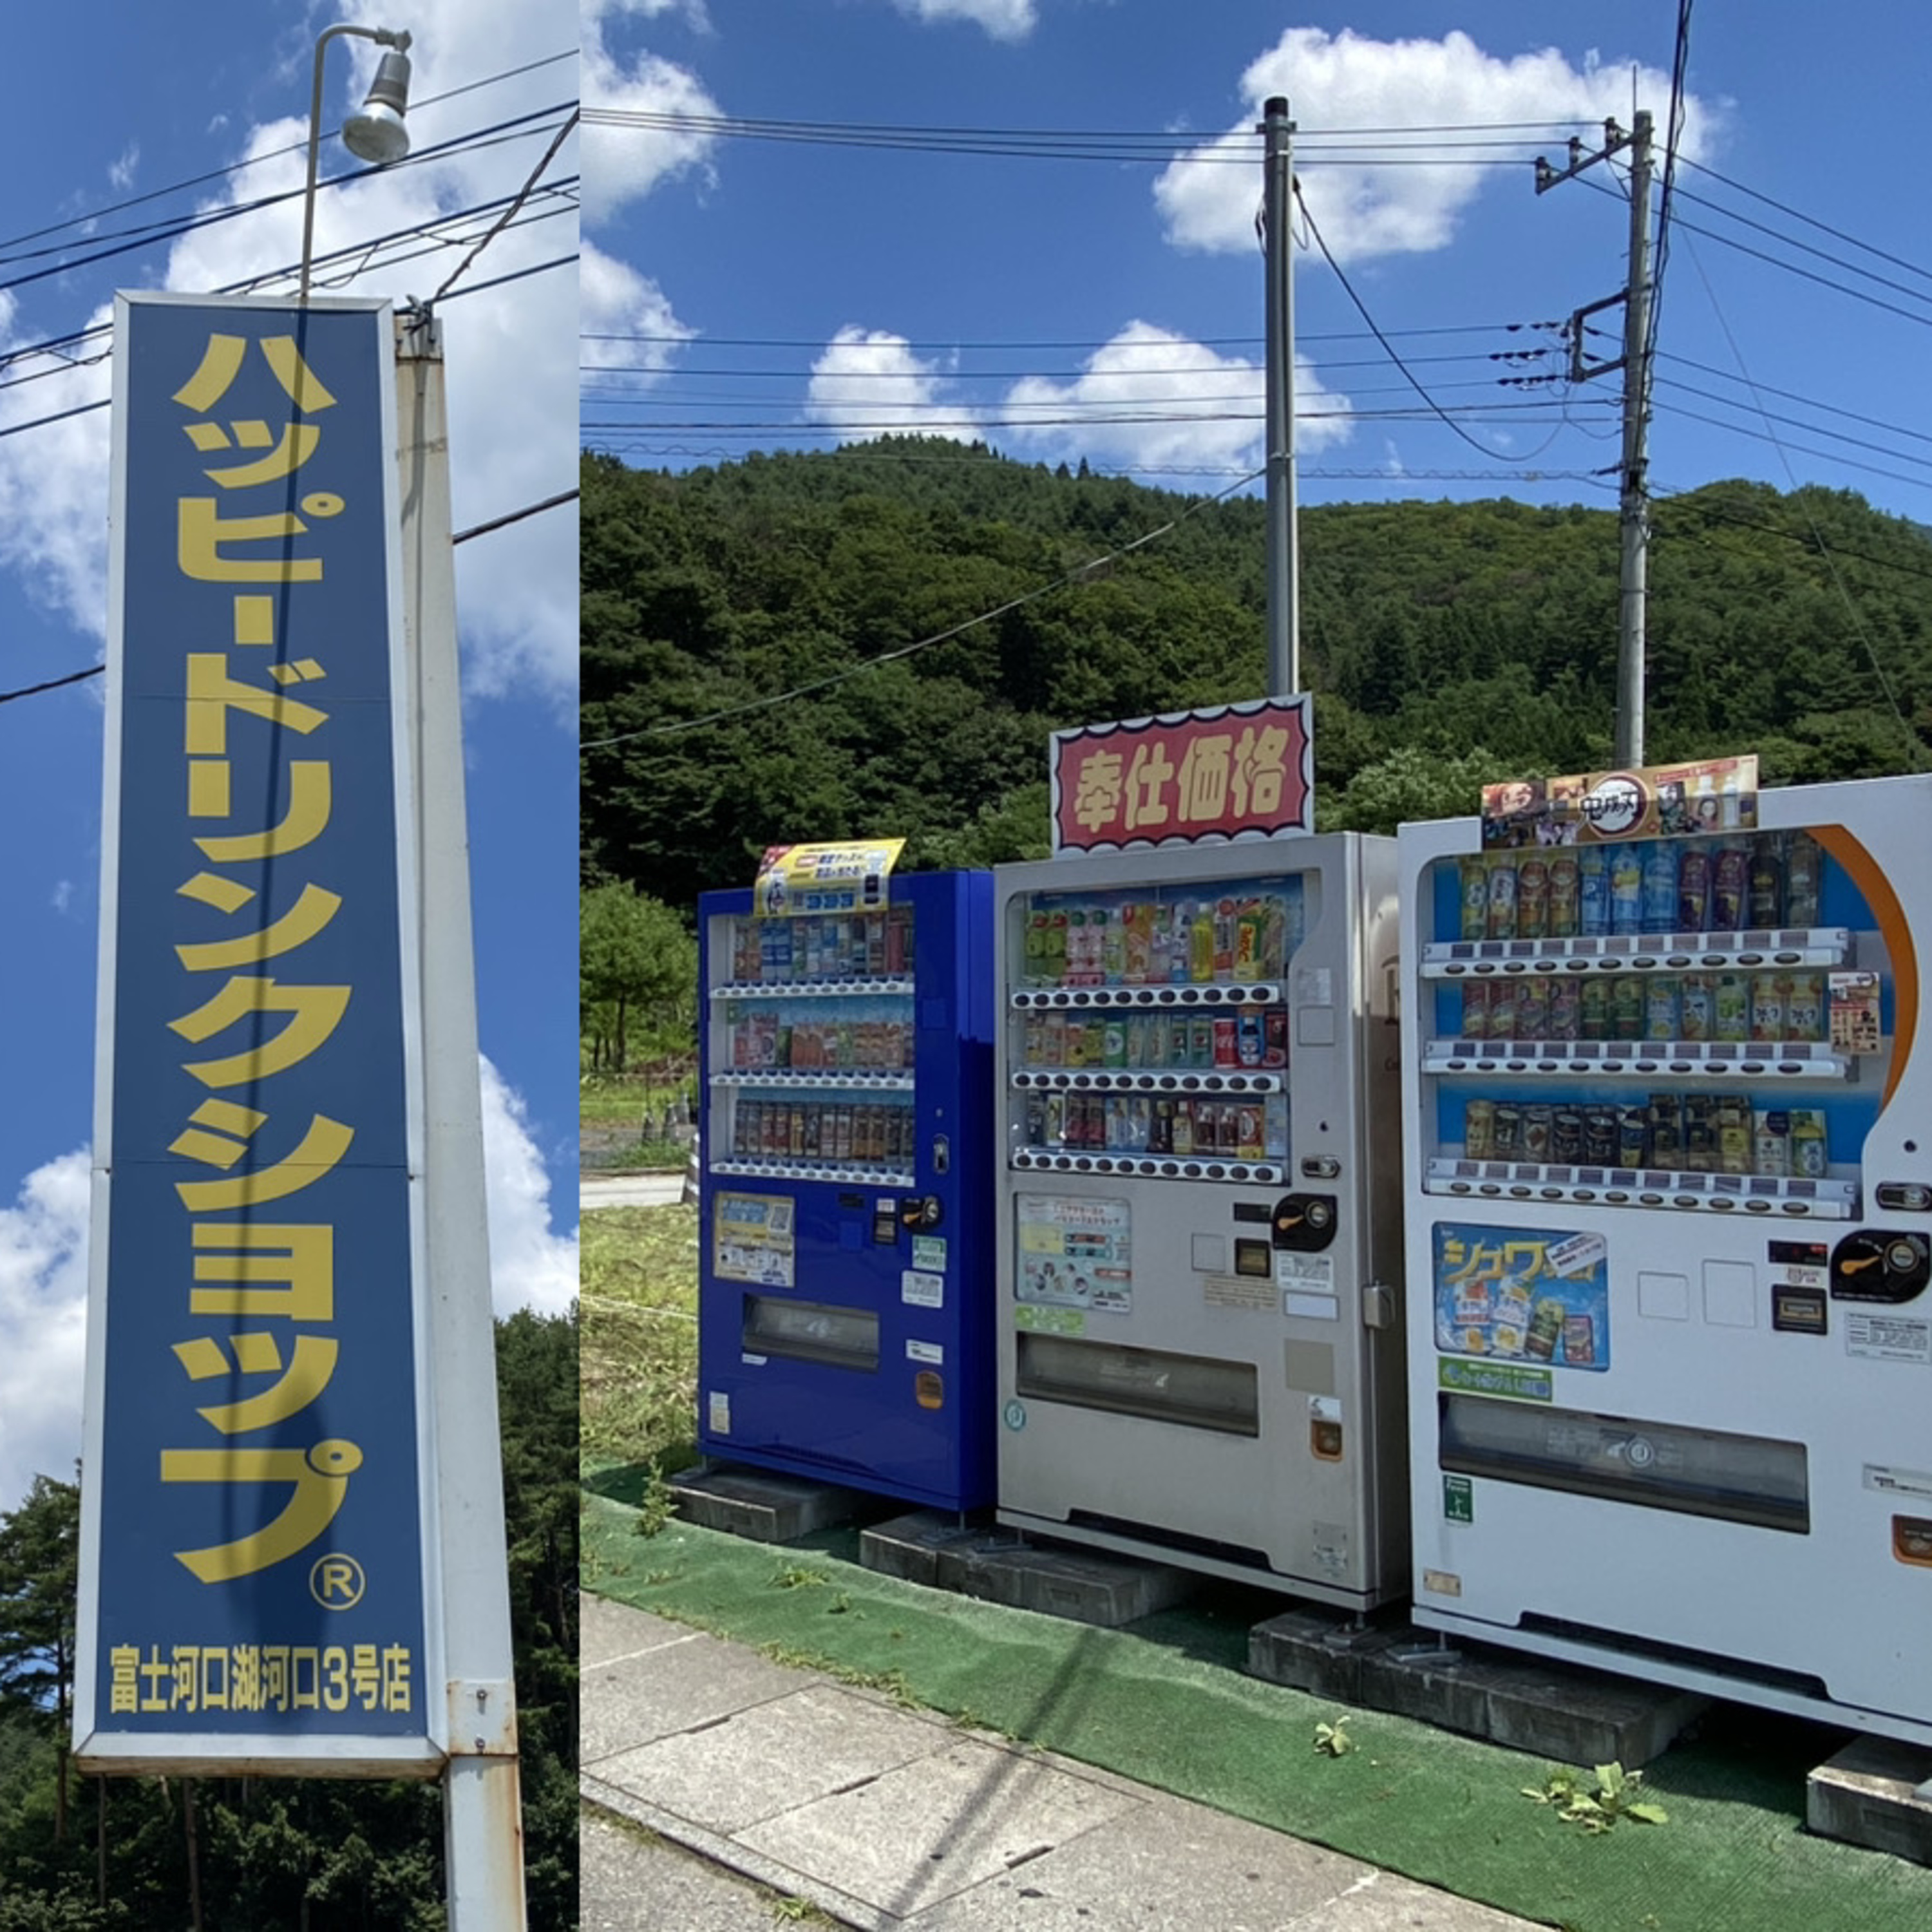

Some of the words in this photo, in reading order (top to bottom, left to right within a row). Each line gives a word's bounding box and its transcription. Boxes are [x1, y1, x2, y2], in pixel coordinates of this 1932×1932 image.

[1074, 725, 1289, 833] 奉仕価格
[161, 334, 363, 1584] ハッピードリンクショップ
[109, 1643, 411, 1713] 富士河口湖河口3号店
